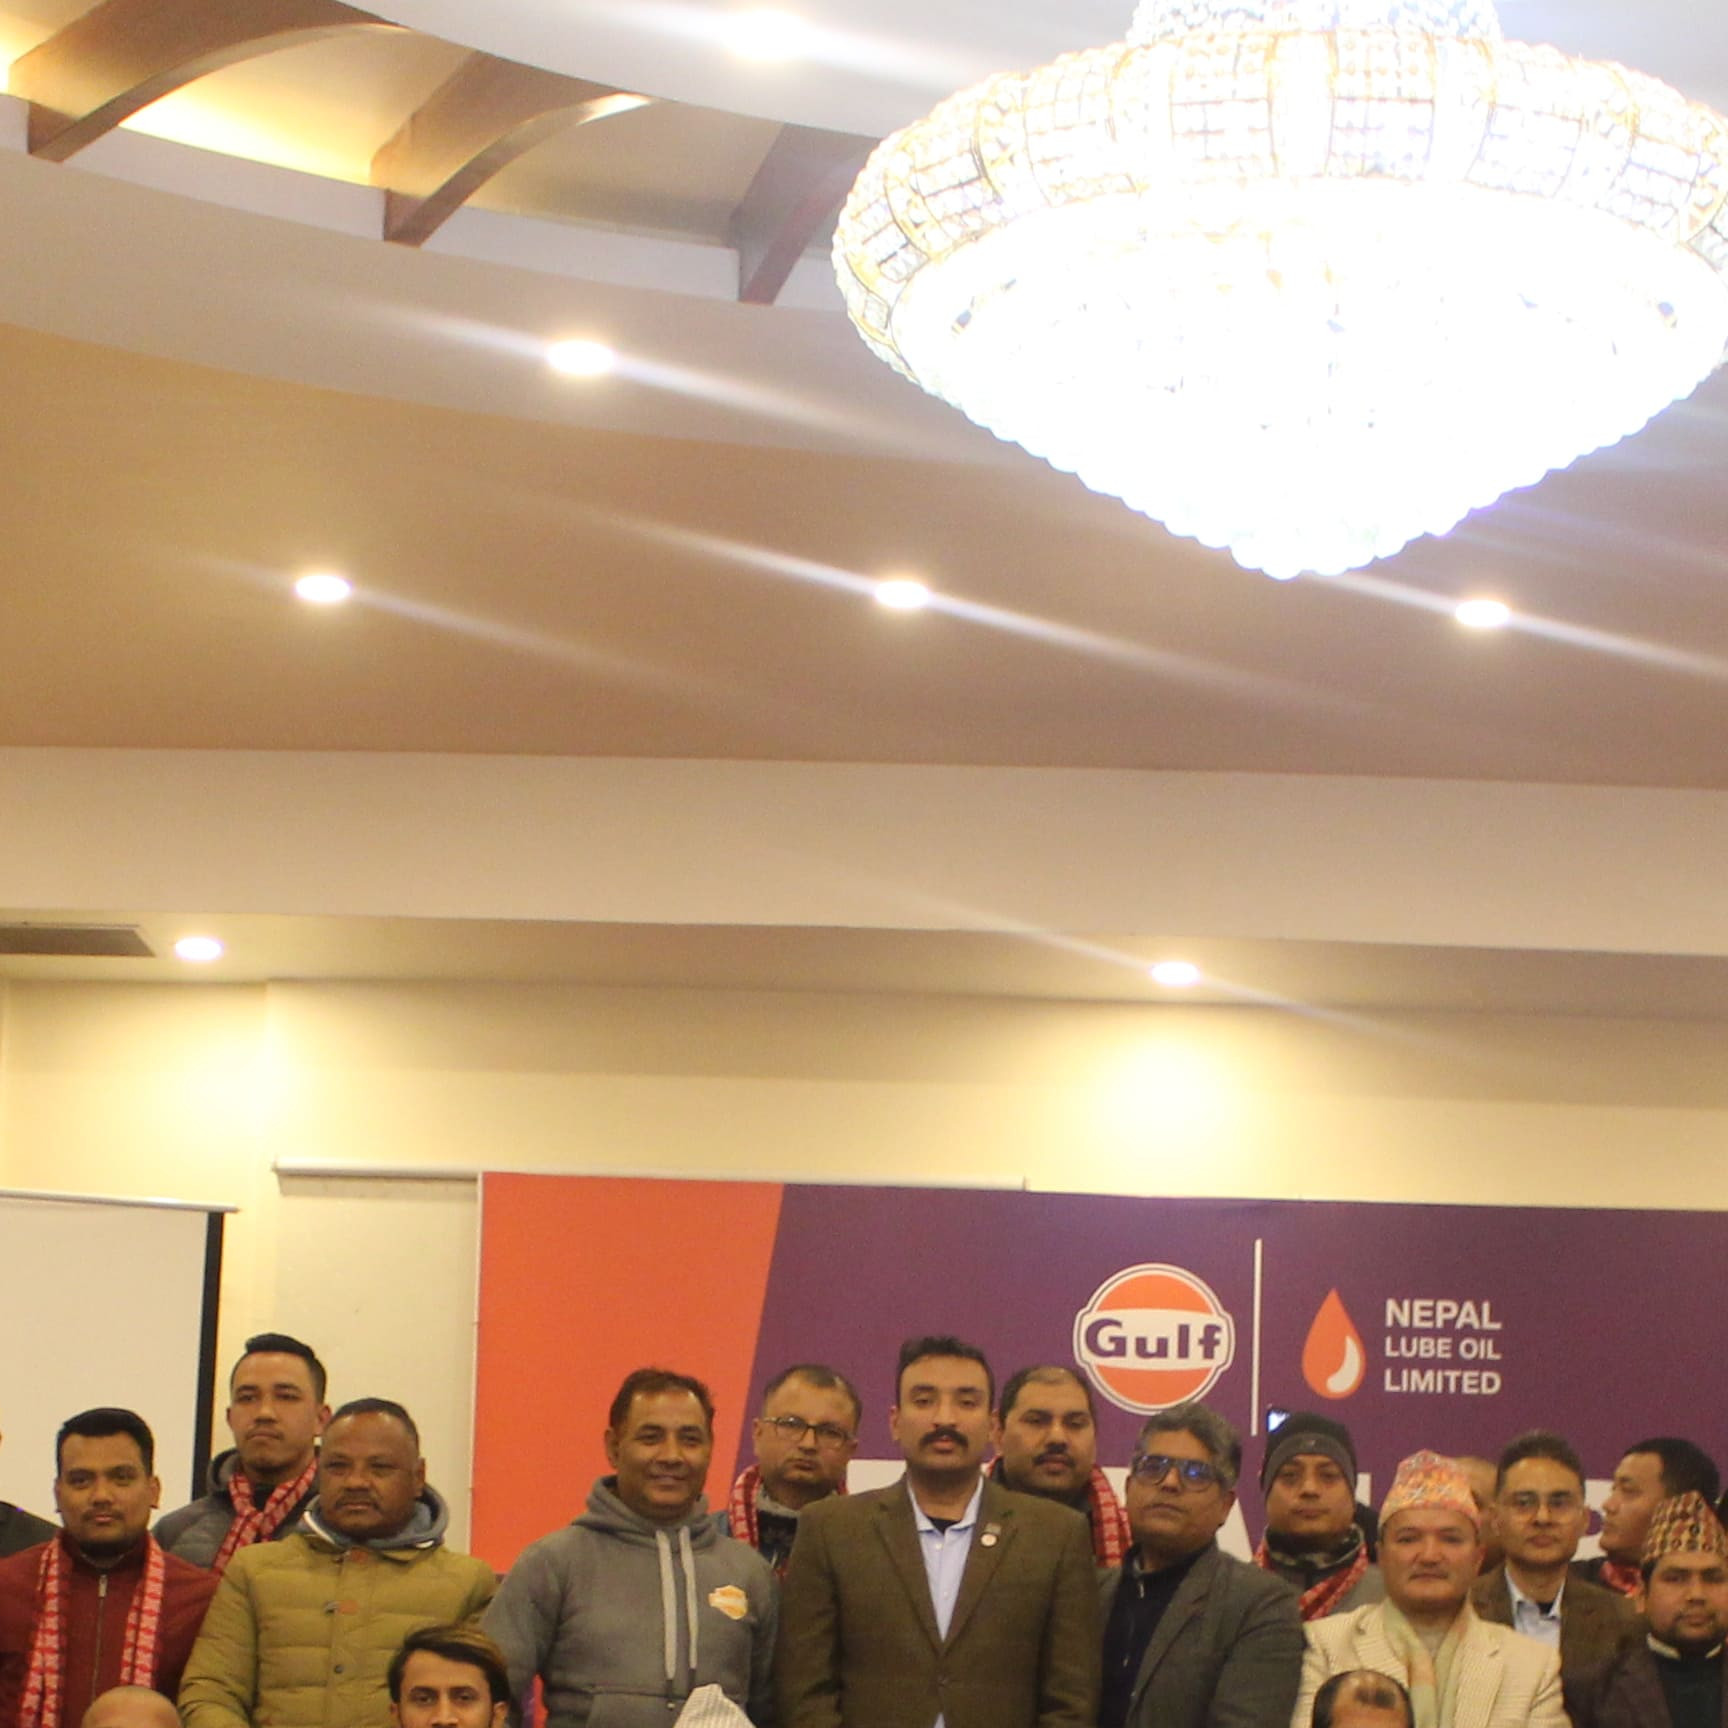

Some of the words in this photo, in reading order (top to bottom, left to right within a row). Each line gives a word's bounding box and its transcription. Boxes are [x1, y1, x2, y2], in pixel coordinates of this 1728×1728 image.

[1385, 1299, 1503, 1331] NEPAL
[1085, 1318, 1222, 1360] Gulf
[1384, 1337, 1453, 1360] LUBE
[1459, 1338, 1502, 1360] OIL
[1384, 1369, 1501, 1395] LIMITED
